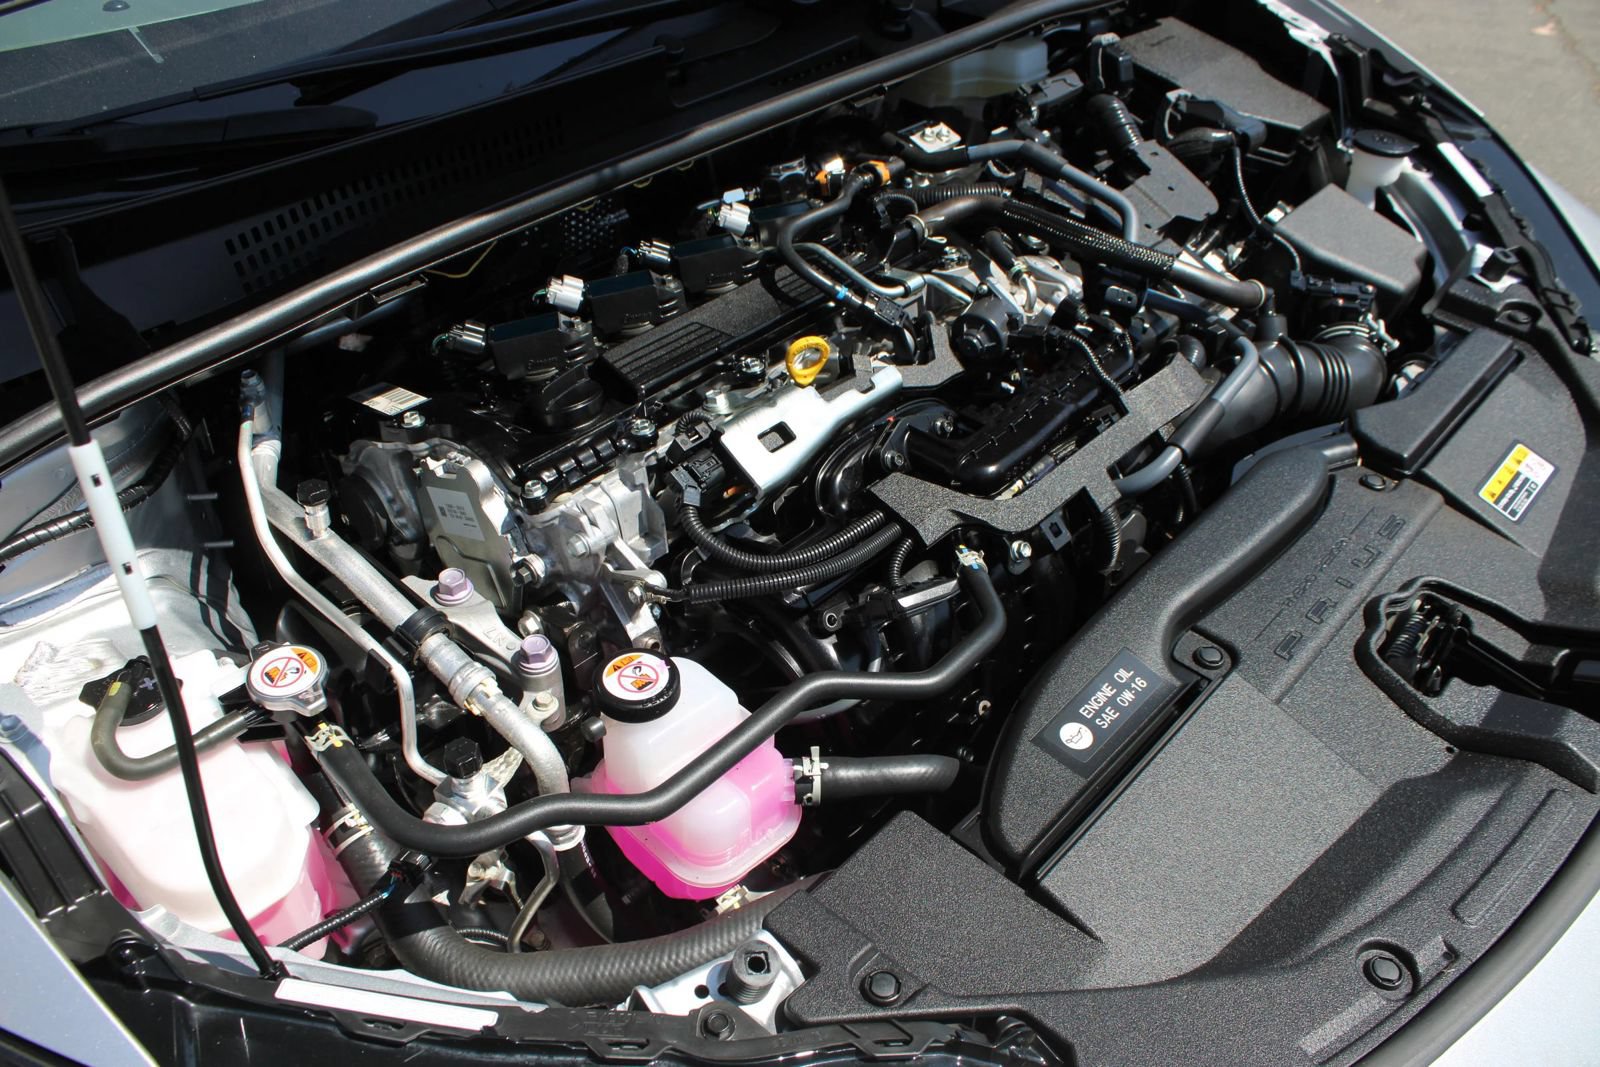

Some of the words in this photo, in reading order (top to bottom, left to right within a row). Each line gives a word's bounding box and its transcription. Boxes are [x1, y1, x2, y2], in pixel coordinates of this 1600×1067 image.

[1274, 514, 1407, 662] PRIUS
[1079, 682, 1117, 719] ENGINE
[1113, 668, 1135, 684] OIL
[1095, 706, 1120, 729] SAE
[1116, 677, 1148, 707] 0W-16
